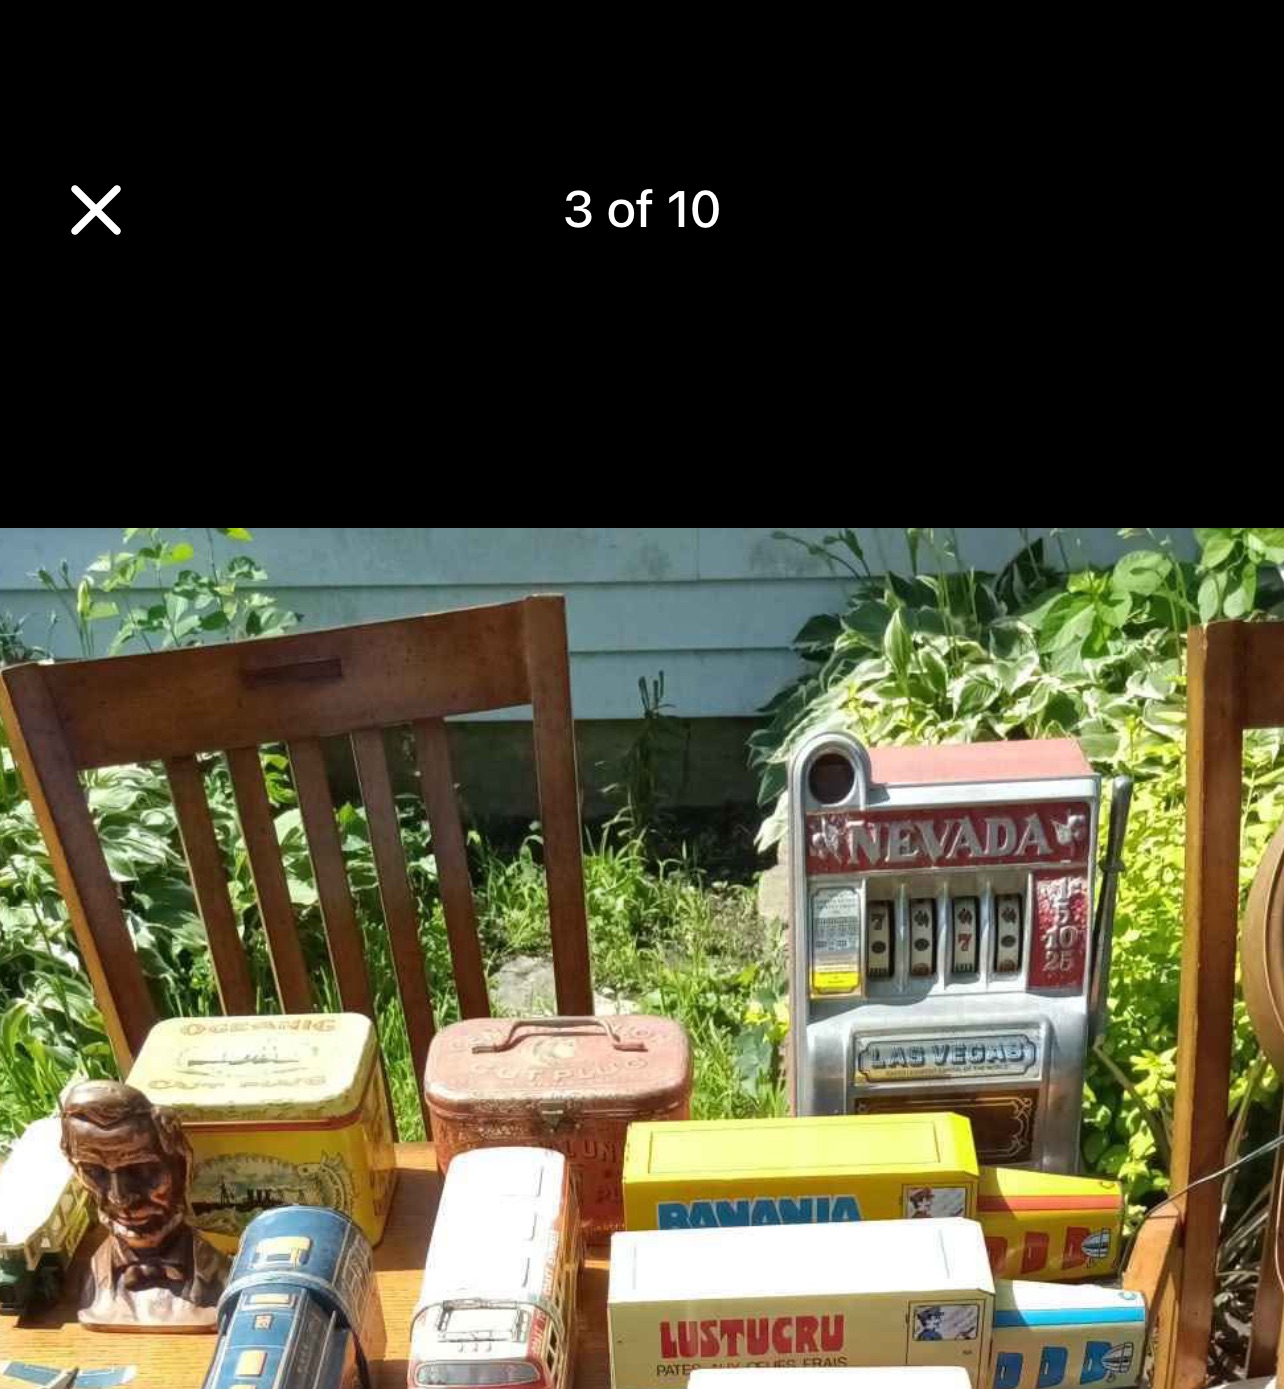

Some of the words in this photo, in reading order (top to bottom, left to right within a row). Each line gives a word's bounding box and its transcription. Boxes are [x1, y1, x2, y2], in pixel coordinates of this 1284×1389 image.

[846, 814, 1053, 866] NEVADA
[870, 1045, 925, 1069] LAS
[932, 1040, 1026, 1066] VEGAS
[657, 1195, 864, 1230] BANANIA
[659, 1315, 845, 1358] LUSTUCRU
